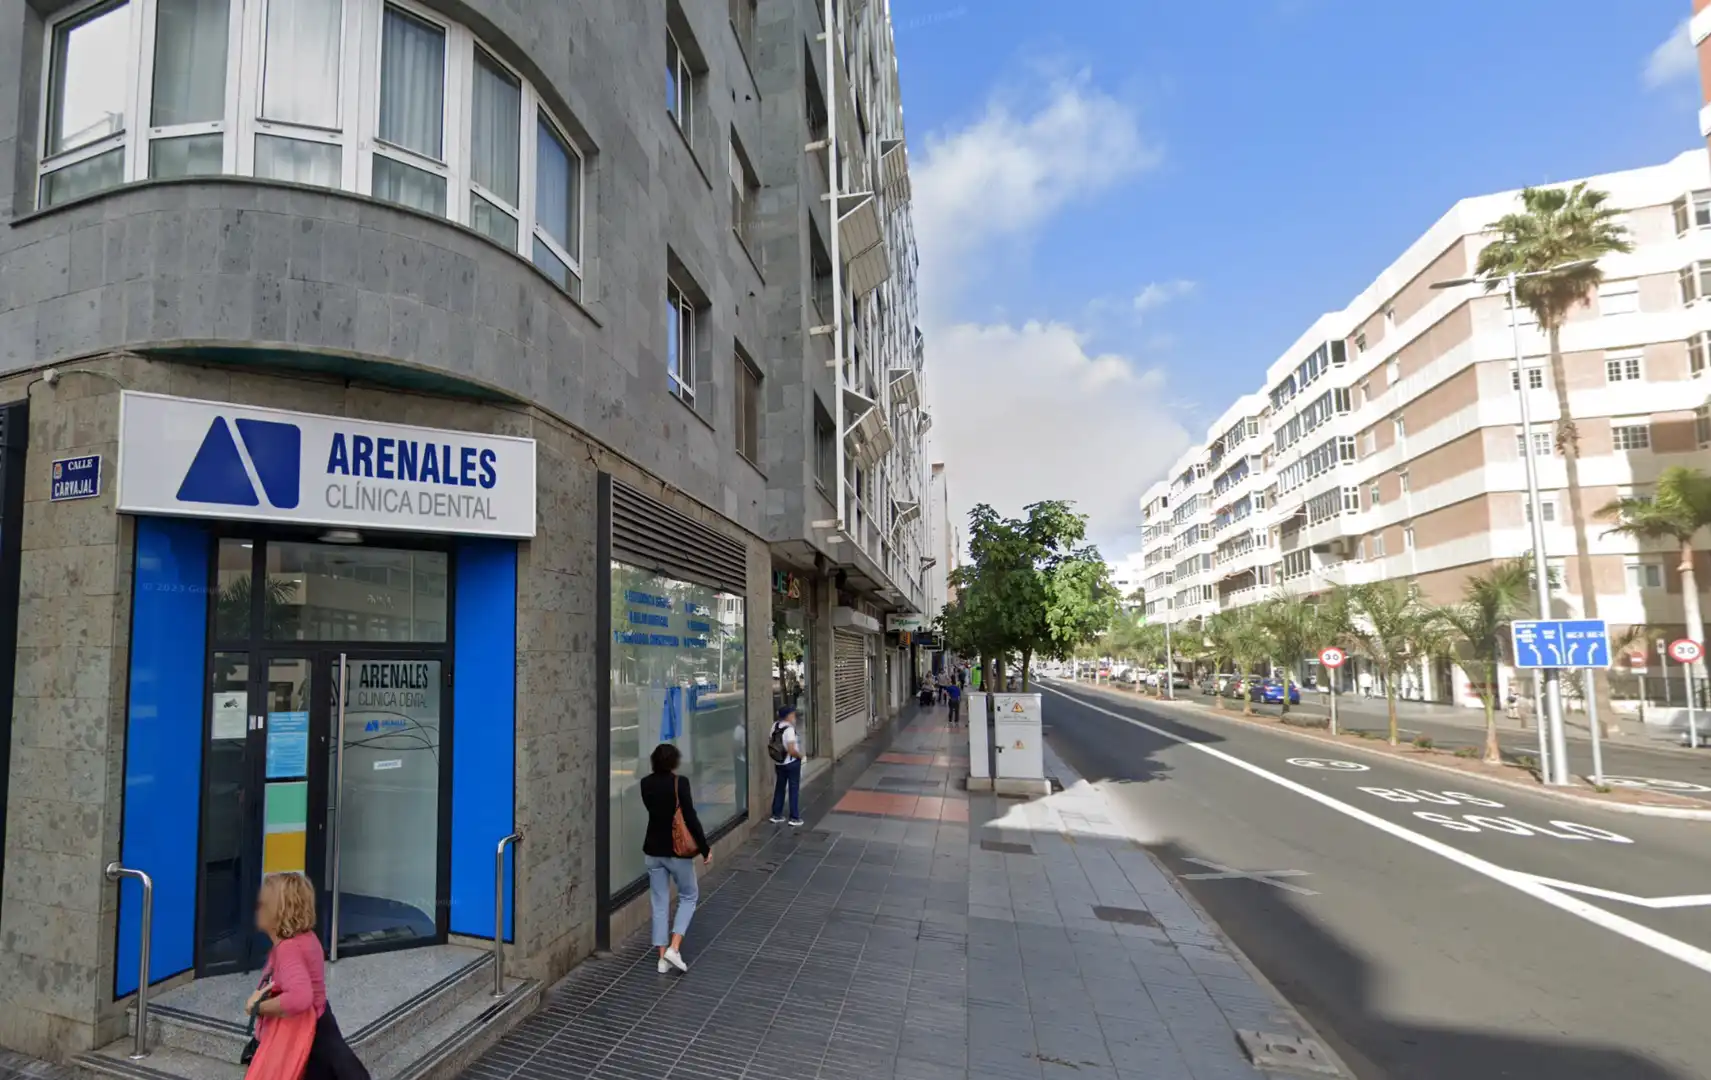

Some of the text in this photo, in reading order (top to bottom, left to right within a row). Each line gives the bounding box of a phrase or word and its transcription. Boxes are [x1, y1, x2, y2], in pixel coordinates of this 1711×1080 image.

[68, 459, 93, 470] CALLE
[326, 432, 497, 489] ARENALES
[54, 479, 94, 497] CARVAJAL
[325, 481, 498, 520] CLÍNICA DENTAL
[359, 663, 429, 689] ARENALES
[1356, 786, 1505, 808] BUS
[1412, 811, 1635, 844] SOLO
